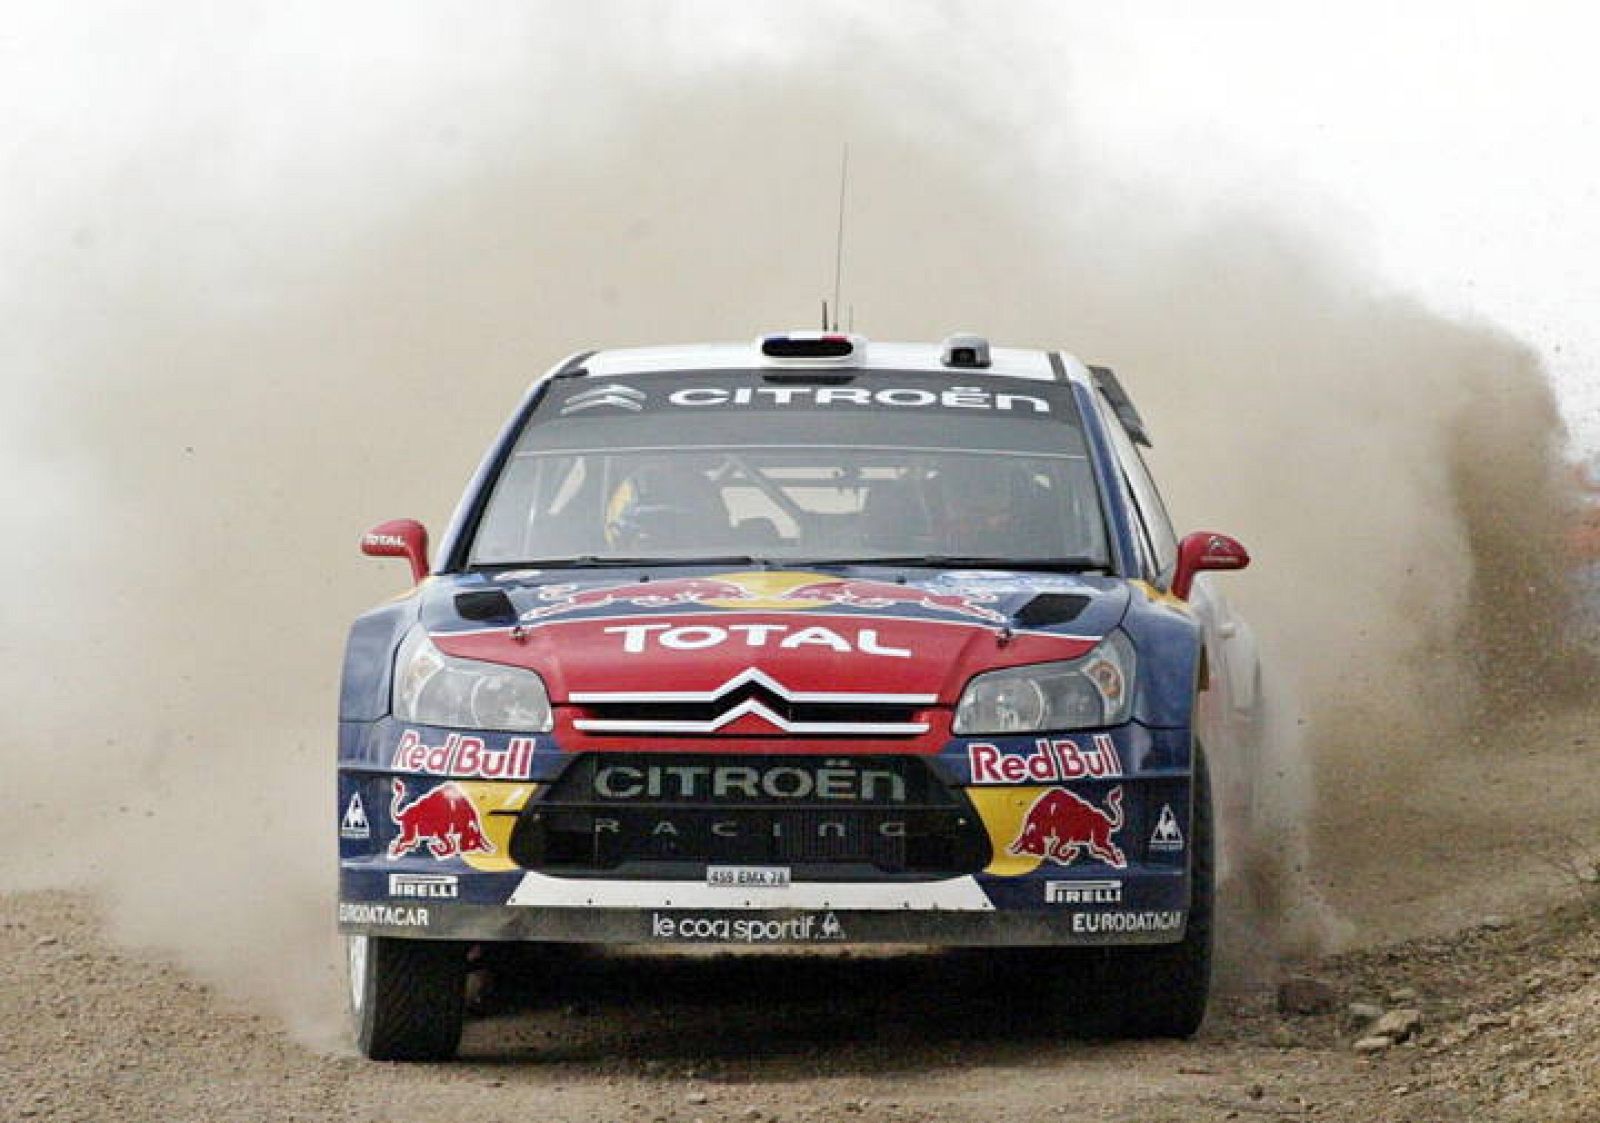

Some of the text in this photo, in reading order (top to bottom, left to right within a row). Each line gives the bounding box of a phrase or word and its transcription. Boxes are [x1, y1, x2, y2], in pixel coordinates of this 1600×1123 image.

[604, 622, 912, 658] TOTAL
[391, 729, 536, 779] Red Bull
[969, 733, 1122, 783] Red Bull
[388, 873, 459, 897] PIRELLI
[1045, 880, 1122, 904] PIRELLI
[652, 913, 677, 938] le
[732, 914, 816, 943] sportif
